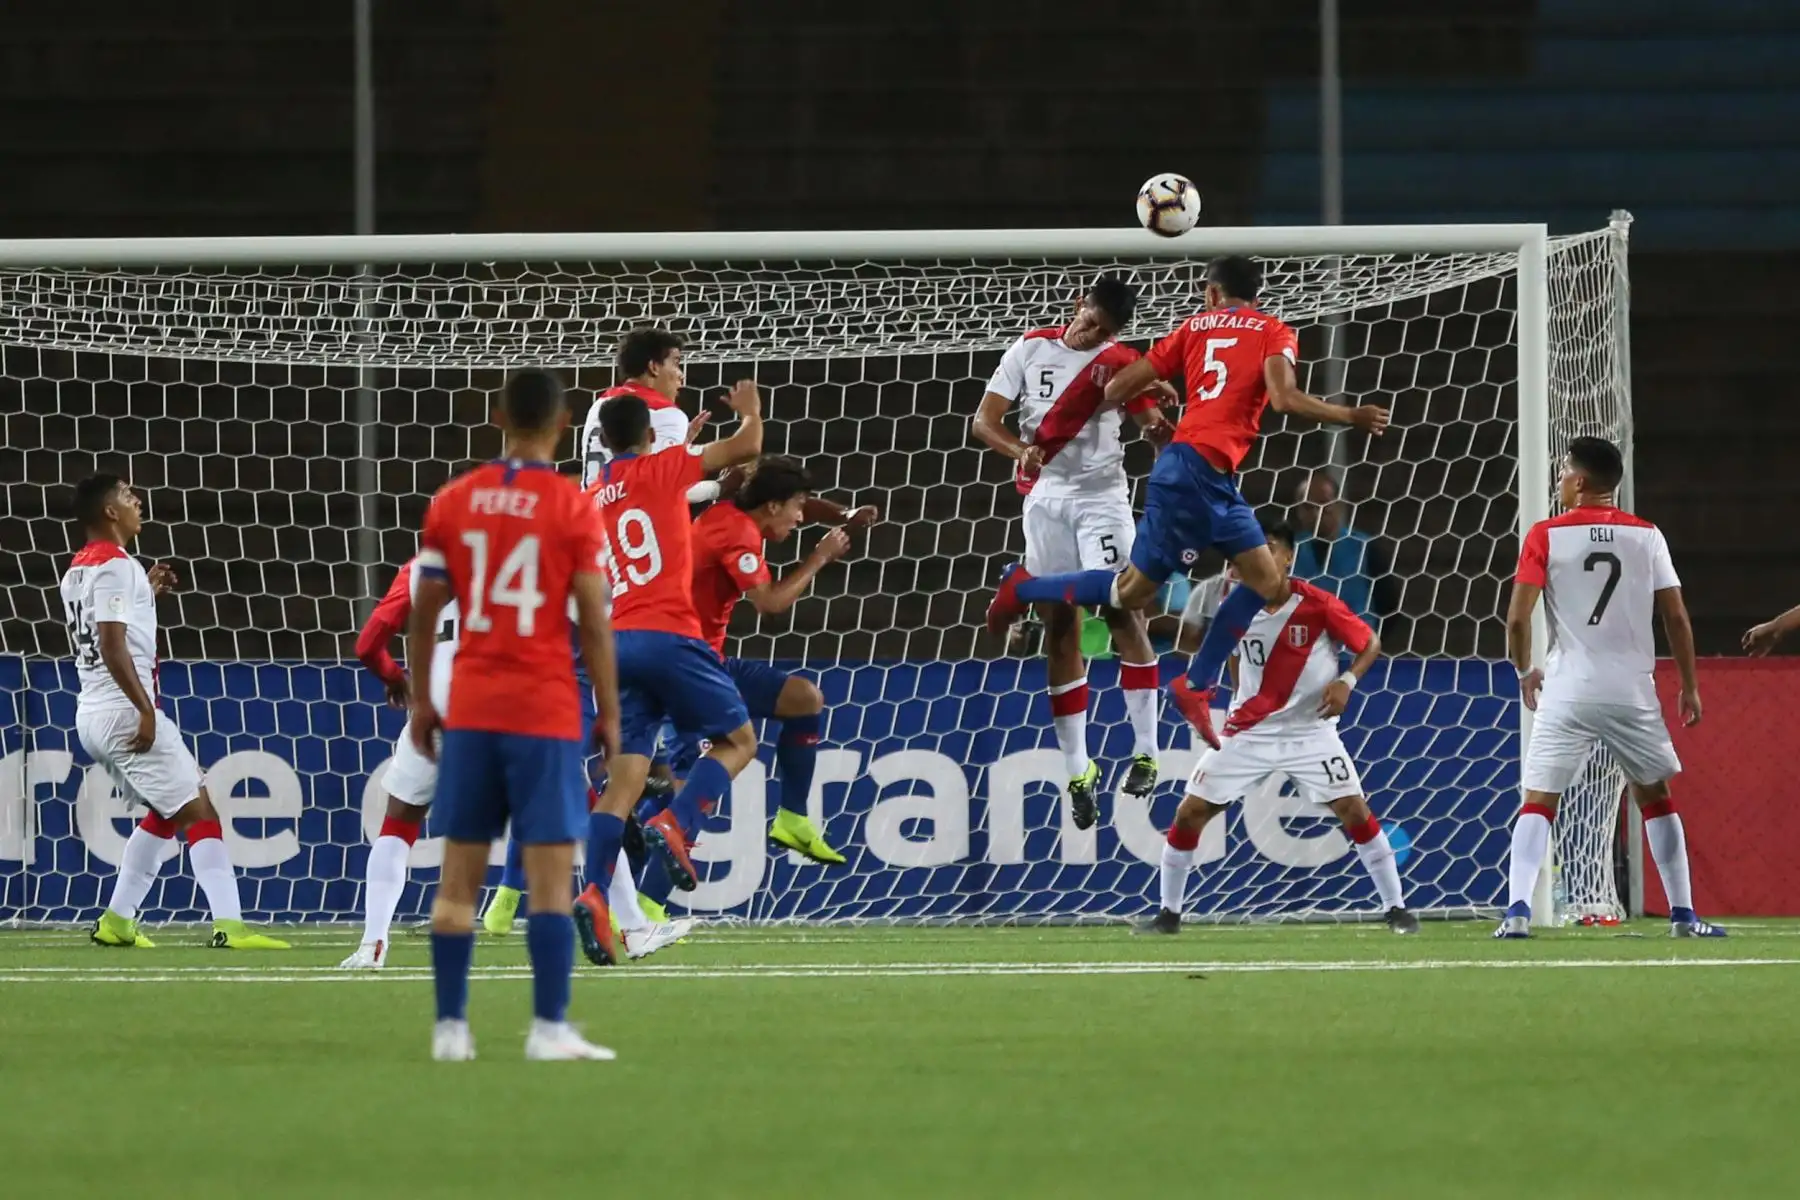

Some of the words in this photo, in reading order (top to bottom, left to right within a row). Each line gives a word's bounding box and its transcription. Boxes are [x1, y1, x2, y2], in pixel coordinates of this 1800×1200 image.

[1190, 314, 1267, 332] GONZALEZ
[1040, 370, 1054, 398] 5
[1197, 338, 1239, 401] 5
[470, 487, 540, 519] PEREZ
[594, 480, 628, 510] ROZ
[1100, 534, 1119, 565] 5
[1590, 527, 1614, 542] CELI
[604, 508, 662, 600] 19
[461, 529, 546, 637] 14
[1583, 552, 1622, 626] 7
[1242, 639, 1266, 667] 13
[1321, 756, 1351, 784] 13
